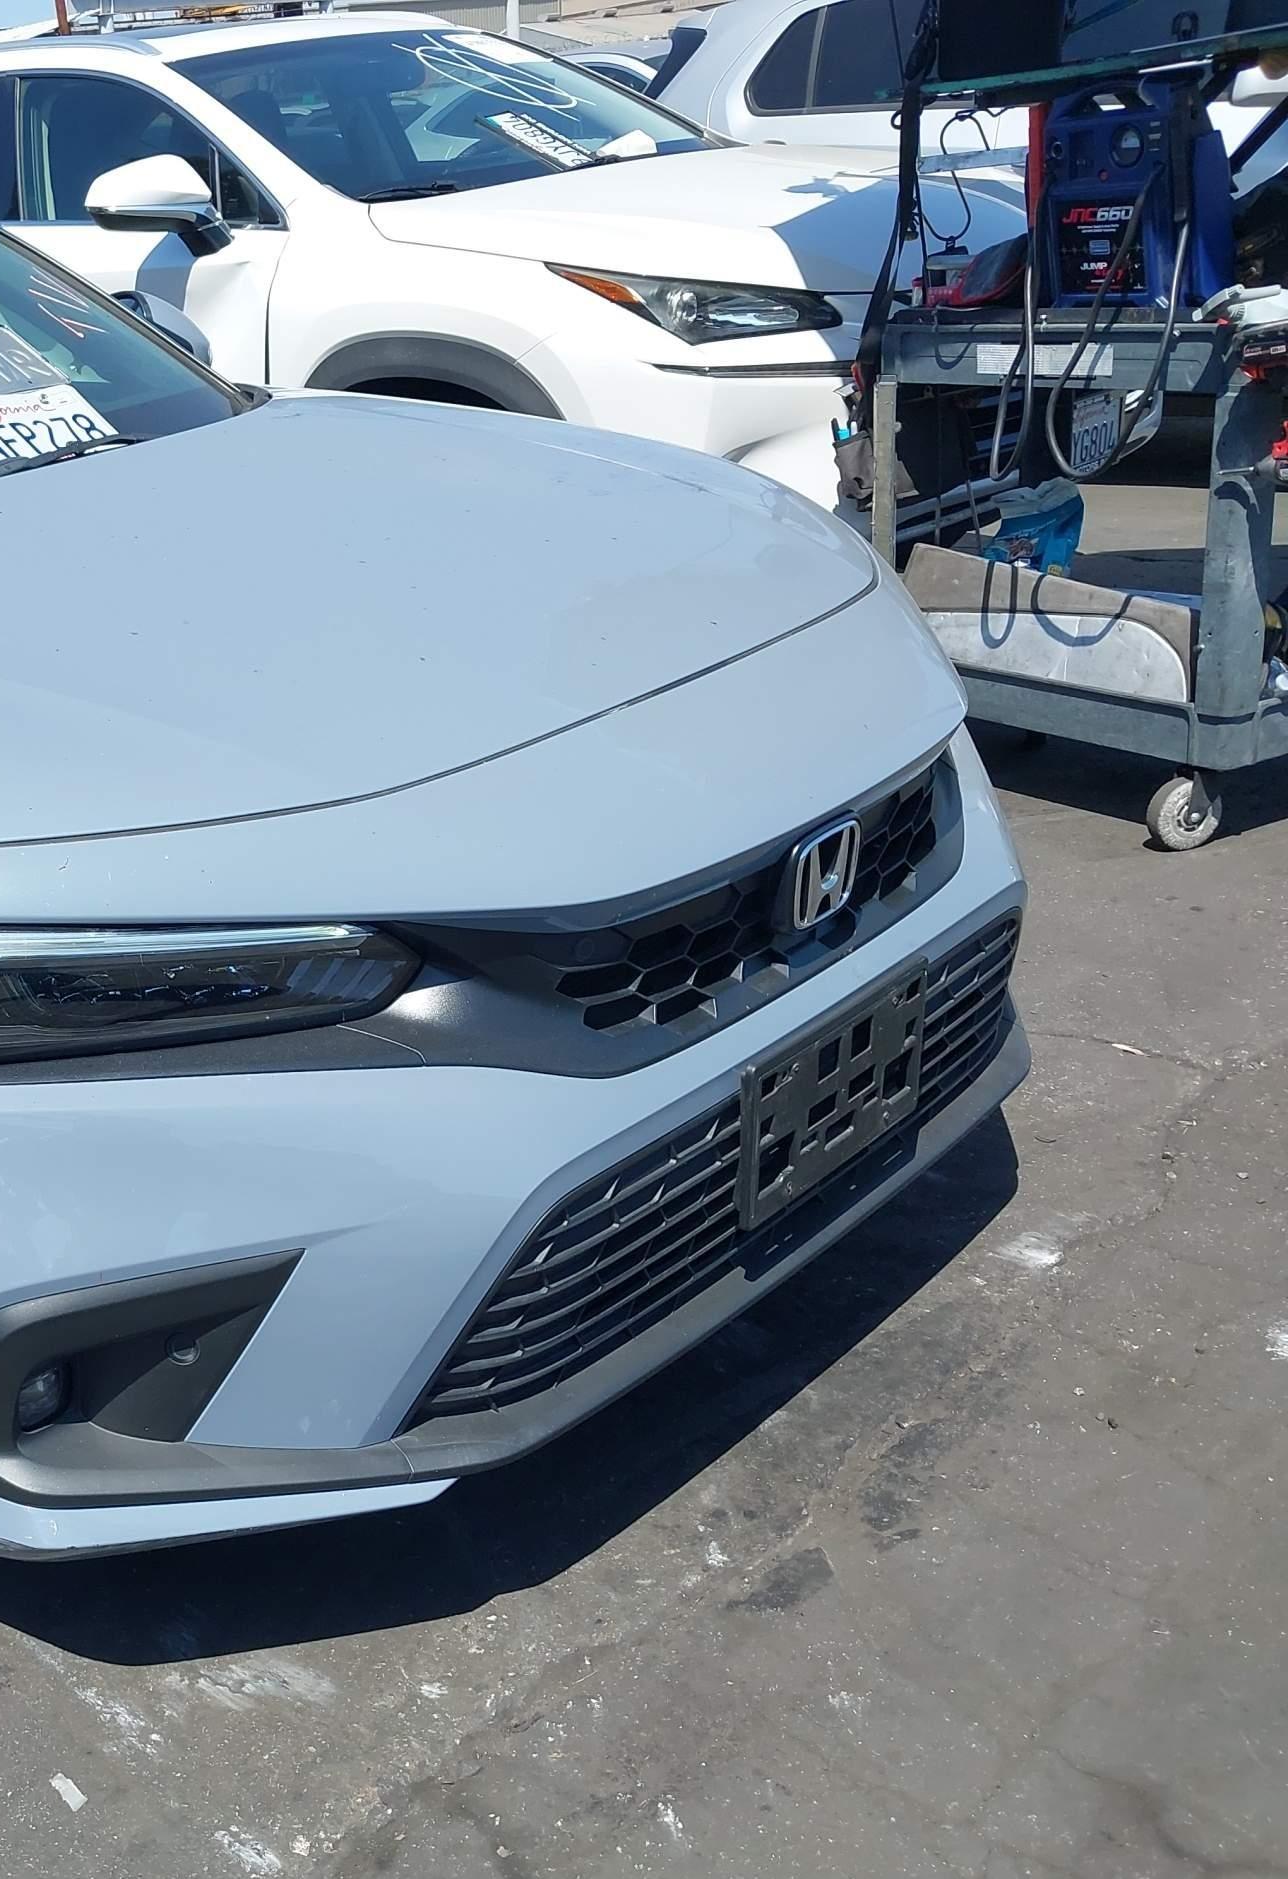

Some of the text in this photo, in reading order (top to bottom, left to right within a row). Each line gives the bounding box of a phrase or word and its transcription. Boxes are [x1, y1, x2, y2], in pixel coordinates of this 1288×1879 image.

[1062, 205, 1134, 224] JNC660
[1080, 261, 1108, 271] JUMP
[1073, 420, 1116, 466] YG804
